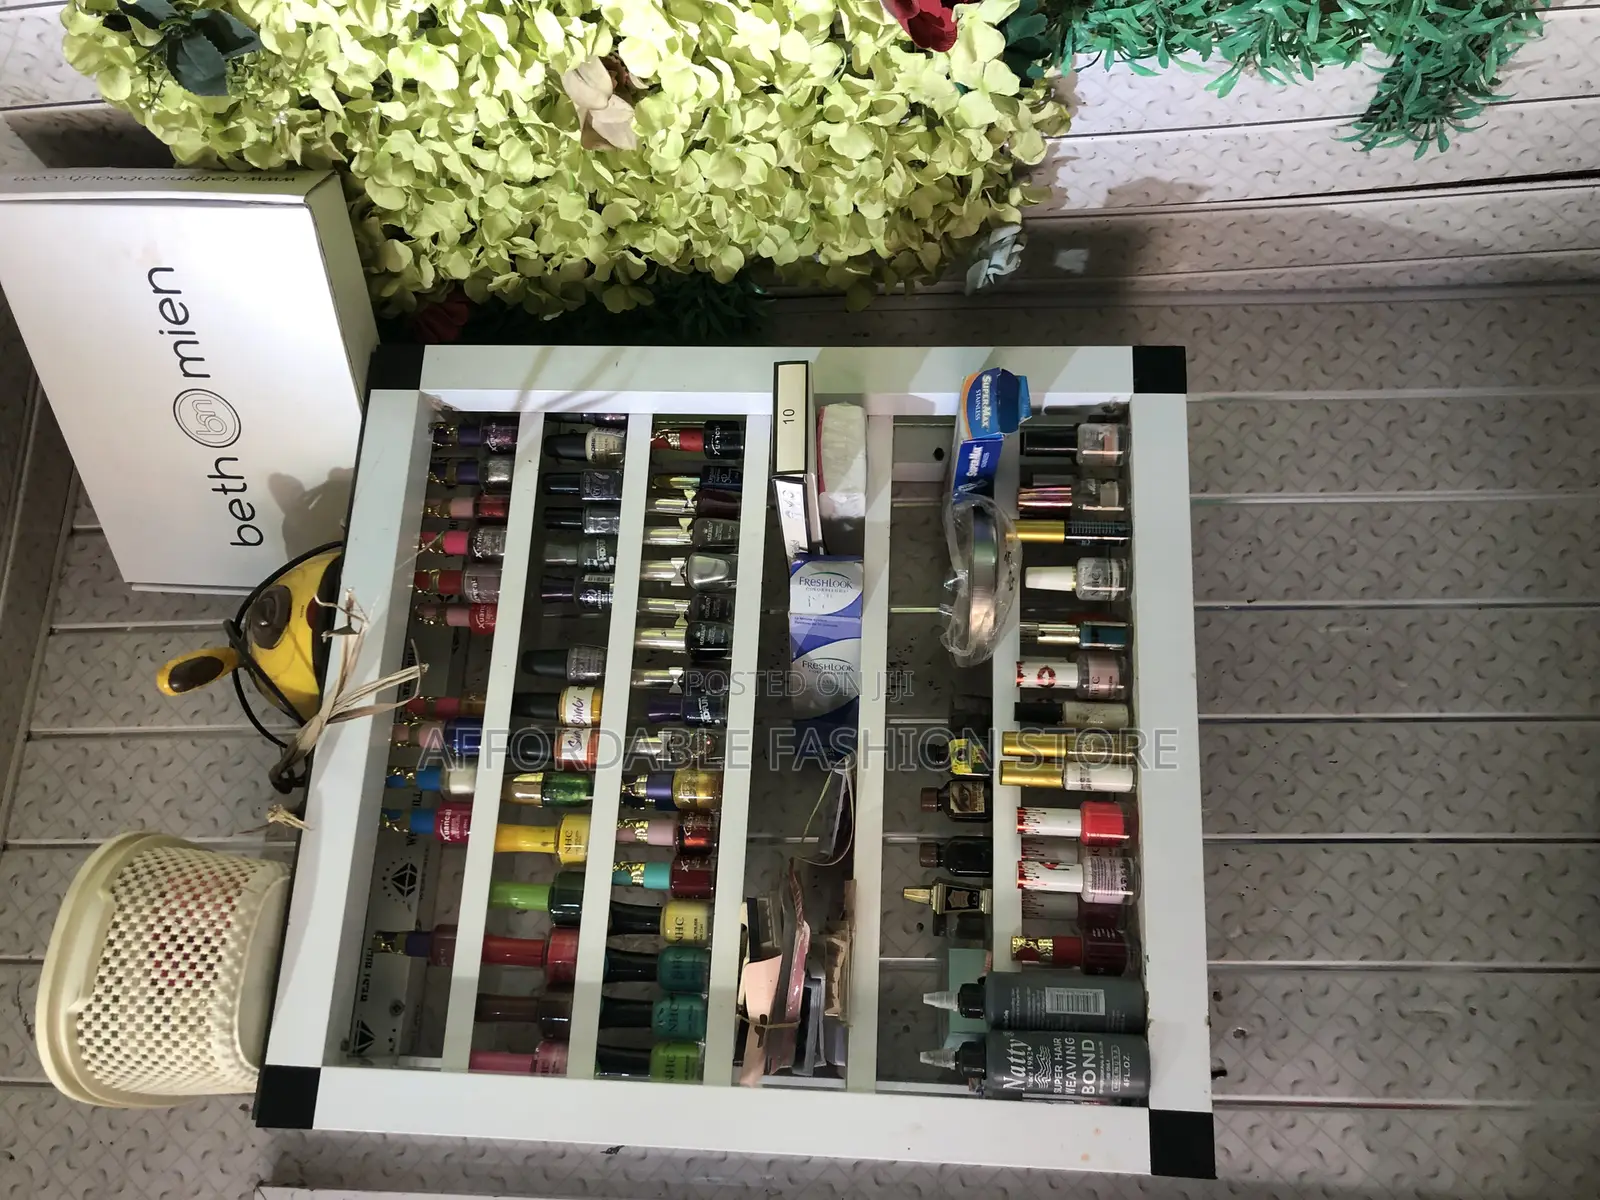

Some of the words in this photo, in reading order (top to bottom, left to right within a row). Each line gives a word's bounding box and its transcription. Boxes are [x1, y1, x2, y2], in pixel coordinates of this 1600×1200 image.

[147, 265, 212, 379] mien
[782, 408, 796, 426] 10
[207, 455, 265, 547] beth
[1002, 1038, 1032, 1091] Natty
[1053, 1037, 1063, 1061] HAIR
[1064, 1036, 1077, 1095] WEAVING
[1081, 1039, 1097, 1095] BOND
[1053, 1064, 1063, 1094] SUPER
